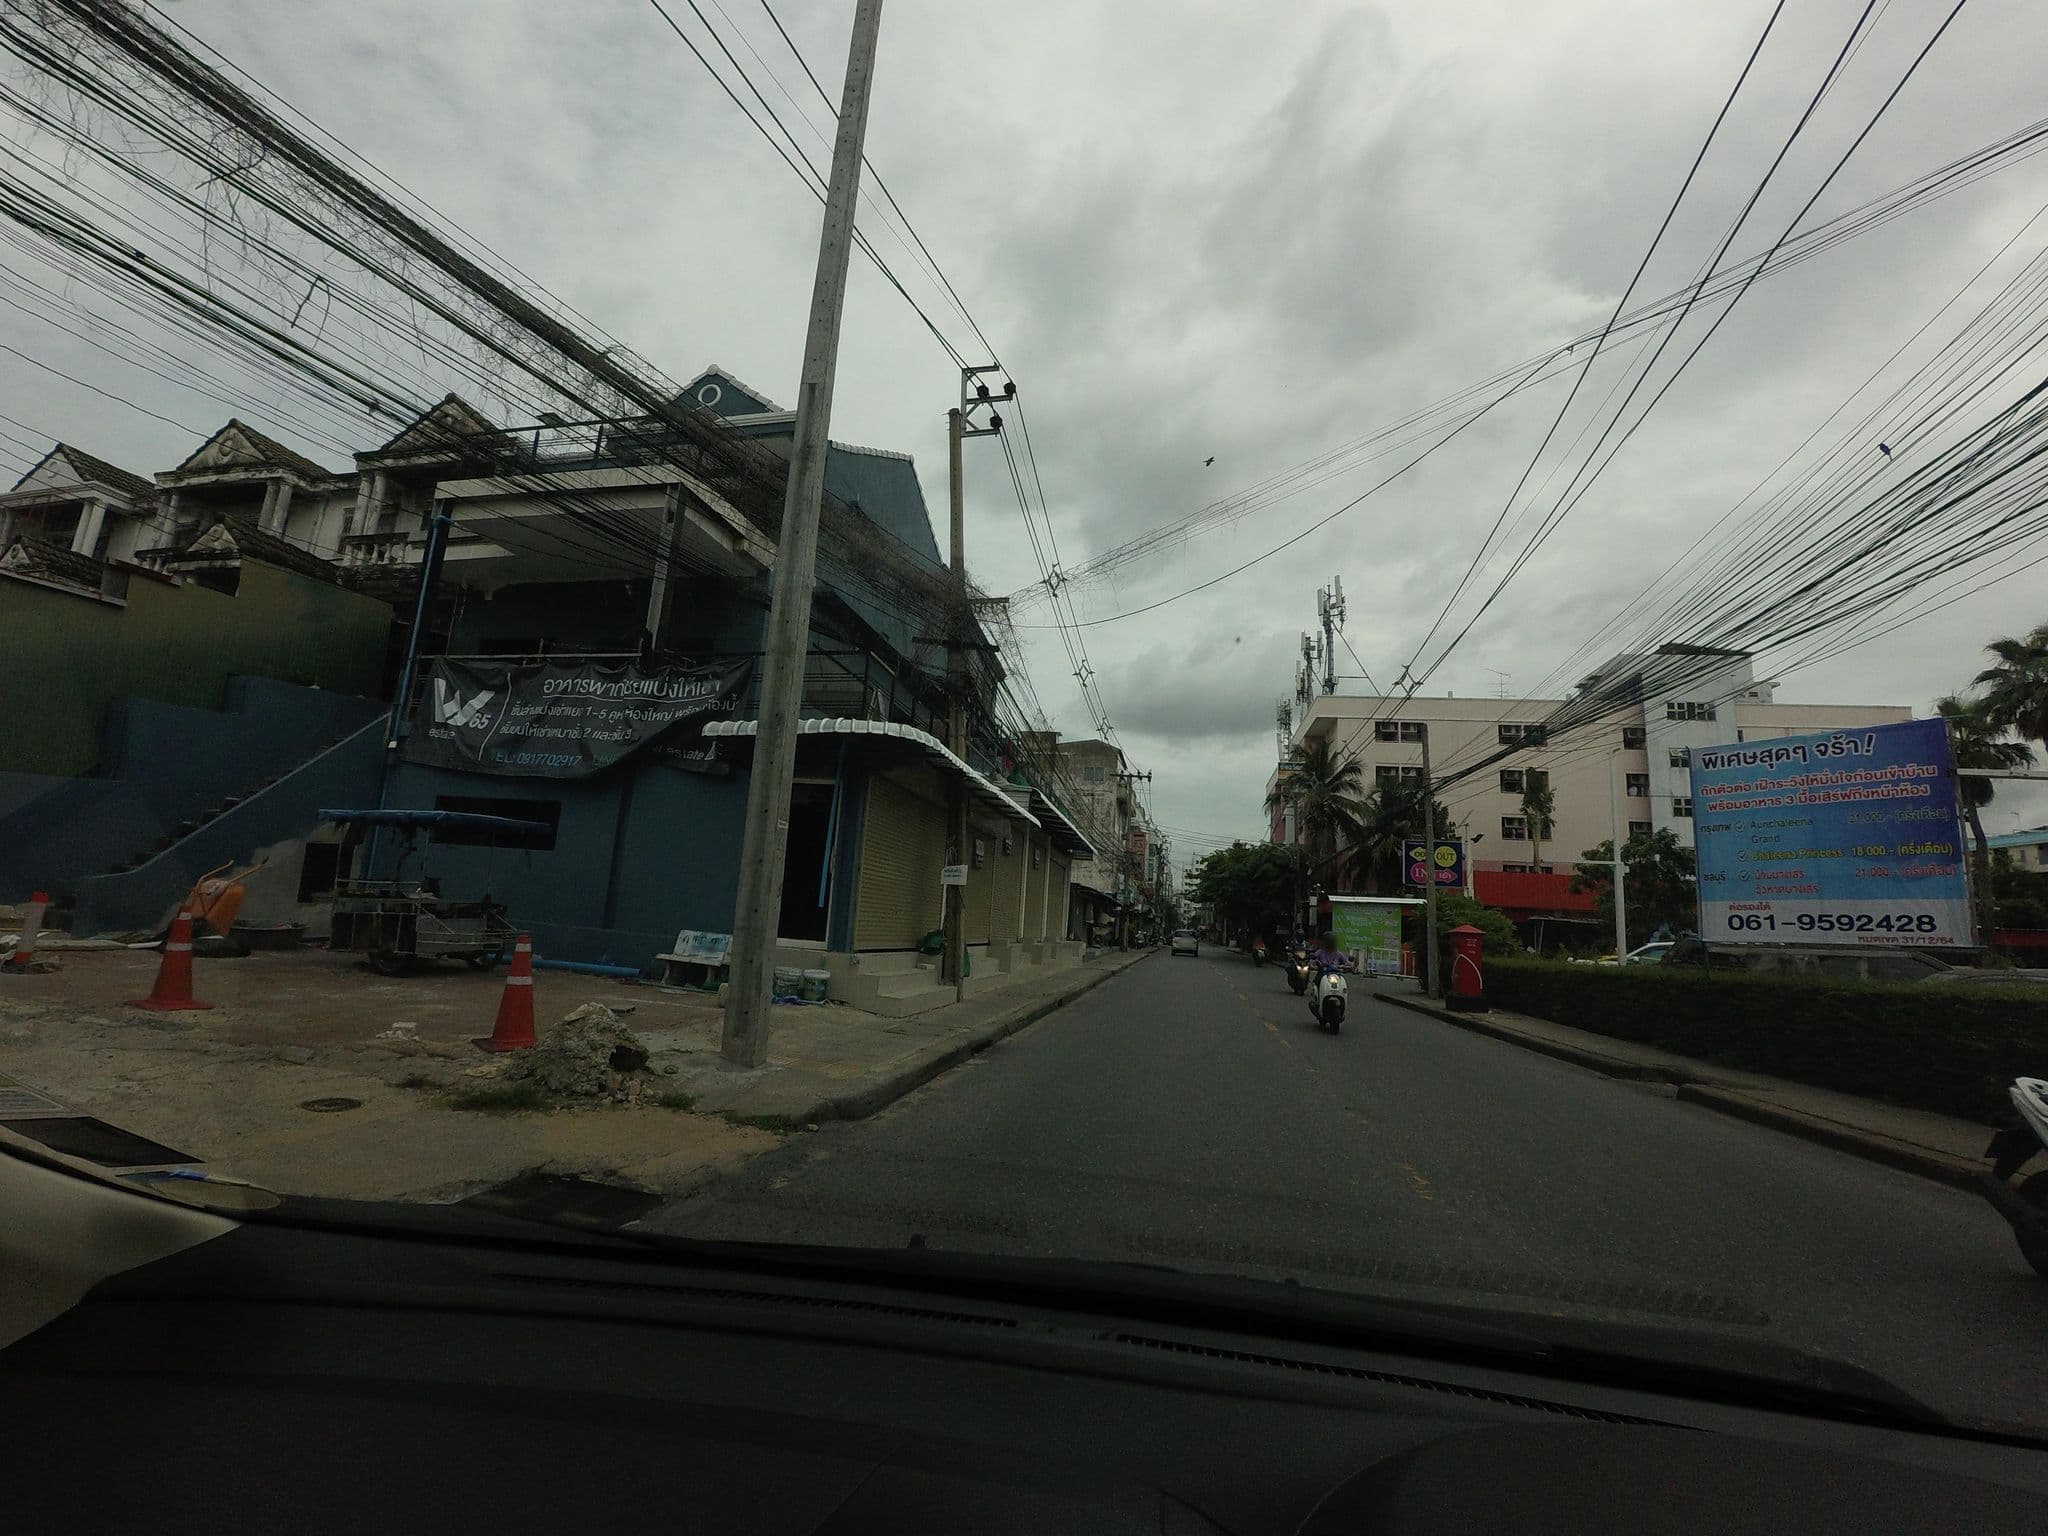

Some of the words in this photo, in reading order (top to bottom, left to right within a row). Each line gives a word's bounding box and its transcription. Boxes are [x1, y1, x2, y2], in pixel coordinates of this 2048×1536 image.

[585, 706, 608, 719] 1-5
[469, 713, 497, 730] 65
[583, 728, 592, 738] 2
[517, 752, 583, 767] 0917702917
[1701, 744, 1808, 770] พิเศษสุดๆ
[1700, 780, 1752, 797] กักตัวต่อ
[1755, 763, 1938, 792] เฝ้าระวังให้มั่นใจก่อนเข้าบ้าน
[1707, 794, 1783, 813] พร้อมอาหาร
[1784, 794, 1796, 806] 3
[1797, 783, 1931, 805] มื้อเสิร์ฟถึงหน้าห้อง
[1436, 852, 1455, 861] OUT
[1703, 870, 1728, 885] ชลบุรี
[1727, 914, 1936, 933] 061-9592428
